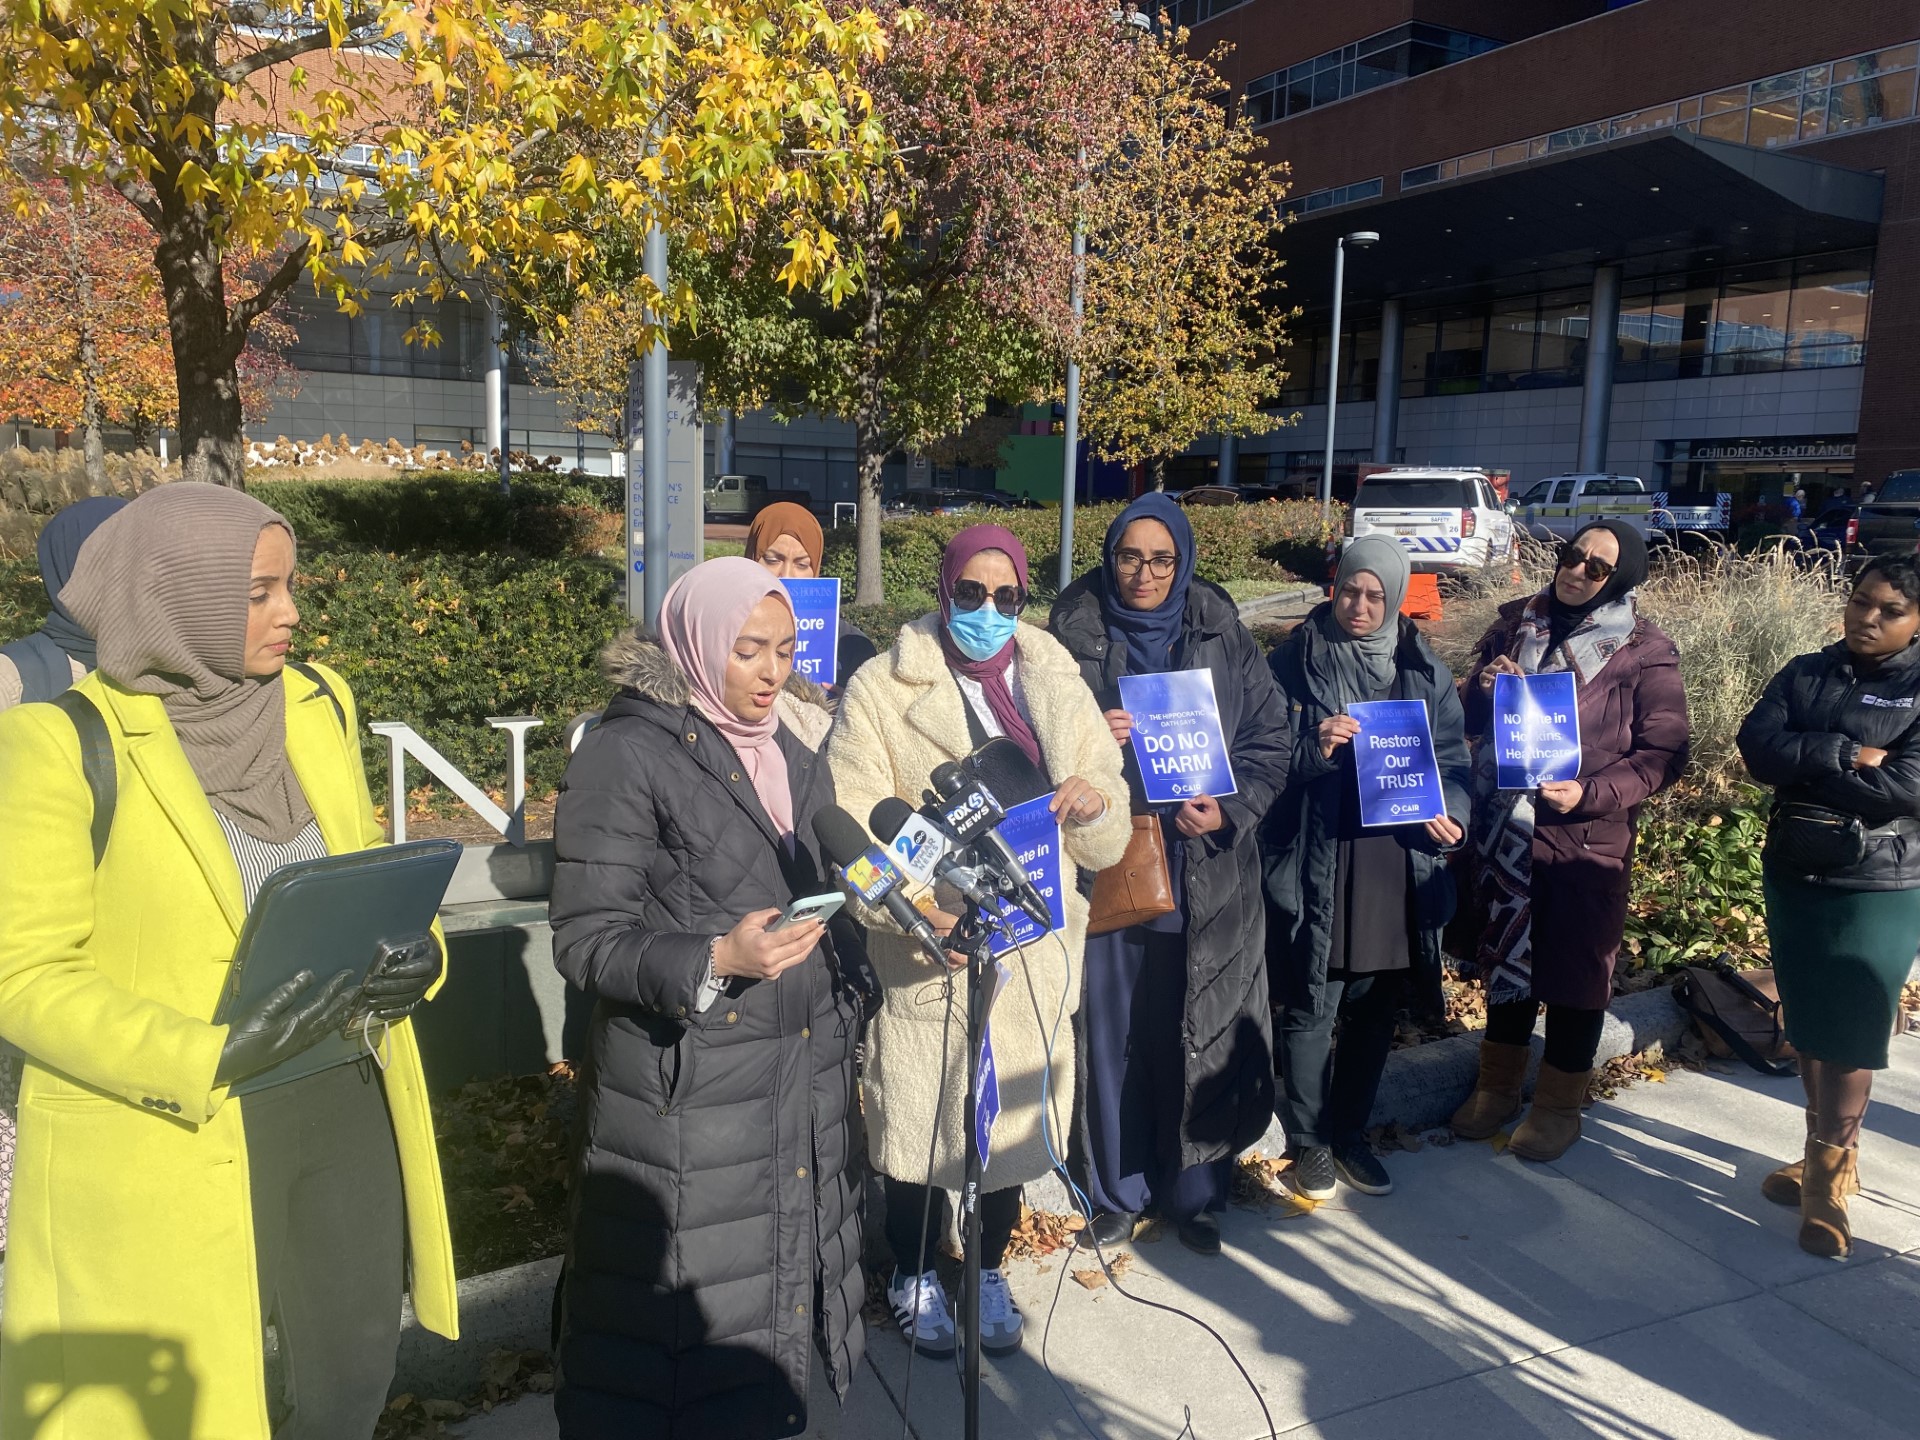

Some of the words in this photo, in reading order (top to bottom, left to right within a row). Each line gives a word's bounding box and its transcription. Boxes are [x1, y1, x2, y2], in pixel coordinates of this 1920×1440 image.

[1696, 446, 1775, 459] CHILDREN'S
[1704, 512, 1712, 520] 12
[668, 550, 695, 560] Available
[794, 616, 825, 630] tore
[795, 640, 810, 652] ur
[792, 659, 822, 674] UST
[1162, 710, 1205, 720] HIPPOCRATIC
[1503, 713, 1522, 725] NO
[1554, 712, 1567, 724] in
[1160, 720, 1179, 728] OATH
[1143, 734, 1175, 753] DO
[1178, 731, 1209, 751] NO
[1369, 734, 1421, 749] Restore
[1511, 731, 1562, 742] Hokins
[1505, 747, 1571, 759] Heathcare
[1151, 753, 1213, 775] HARM
[1385, 754, 1411, 769] Our
[1182, 784, 1202, 792] CAIR
[1376, 773, 1425, 790] TRUST
[945, 802, 973, 827] FOX
[1401, 804, 1420, 812] CAIR
[956, 805, 990, 835] NEWS
[915, 831, 925, 844] abc
[895, 835, 922, 865] 2
[911, 837, 936, 868] WMAR
[1017, 850, 1036, 865] ate
[1037, 843, 1049, 858] in
[918, 845, 939, 871] NEWS
[1015, 923, 1034, 937] CAIR
